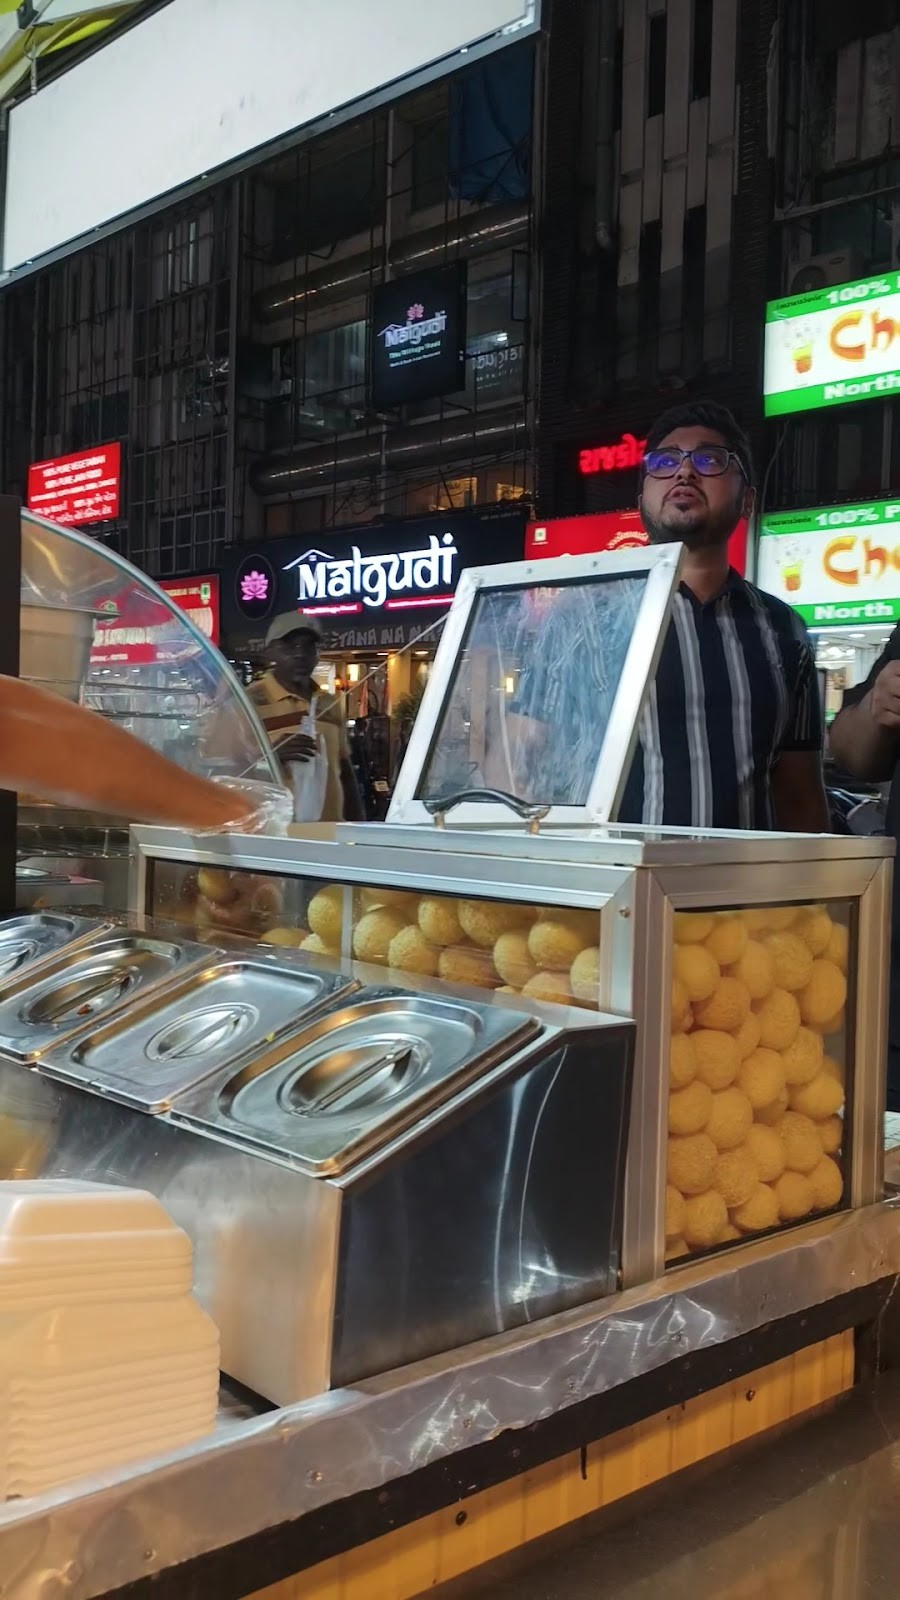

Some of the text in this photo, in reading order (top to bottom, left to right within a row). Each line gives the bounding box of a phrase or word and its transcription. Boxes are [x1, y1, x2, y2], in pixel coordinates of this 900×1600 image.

[826, 278, 891, 305] 100%
[384, 309, 448, 347] Malgudi
[815, 507, 880, 526] 100%
[297, 532, 458, 608] Malgudi
[813, 602, 894, 620] North
[338, 628, 377, 648] TANA
[380, 625, 405, 646] NA
